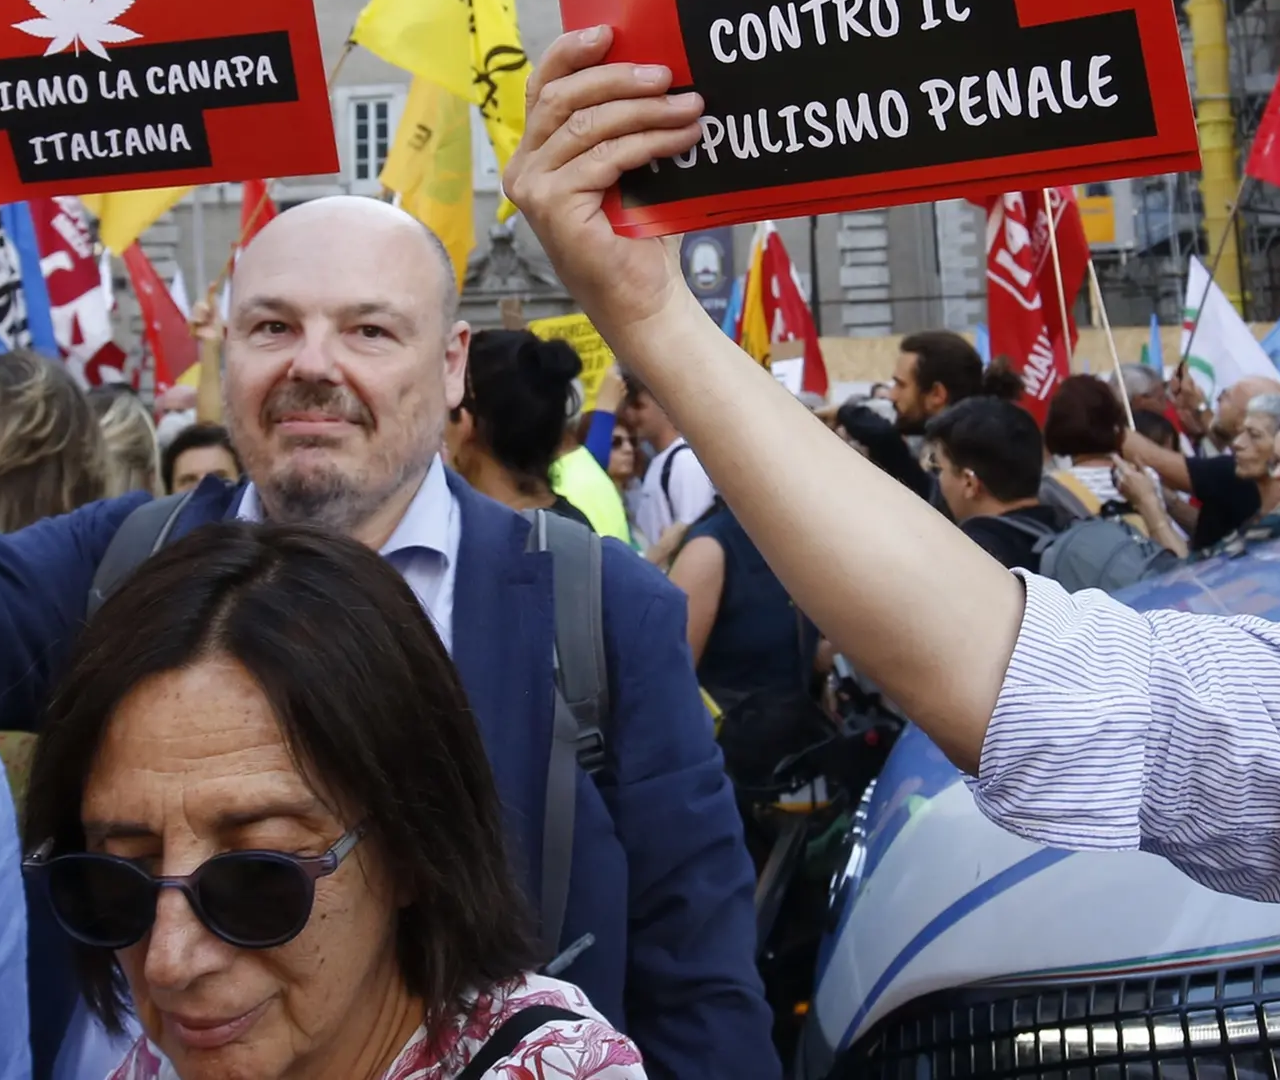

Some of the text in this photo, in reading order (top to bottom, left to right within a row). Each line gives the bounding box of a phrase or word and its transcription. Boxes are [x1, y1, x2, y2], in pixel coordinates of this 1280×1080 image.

[99, 70, 138, 99] LA
[146, 56, 277, 94] CANAPA
[650, 55, 1118, 172] PULISMO PENALE
[29, 124, 191, 164] ITALIANA
